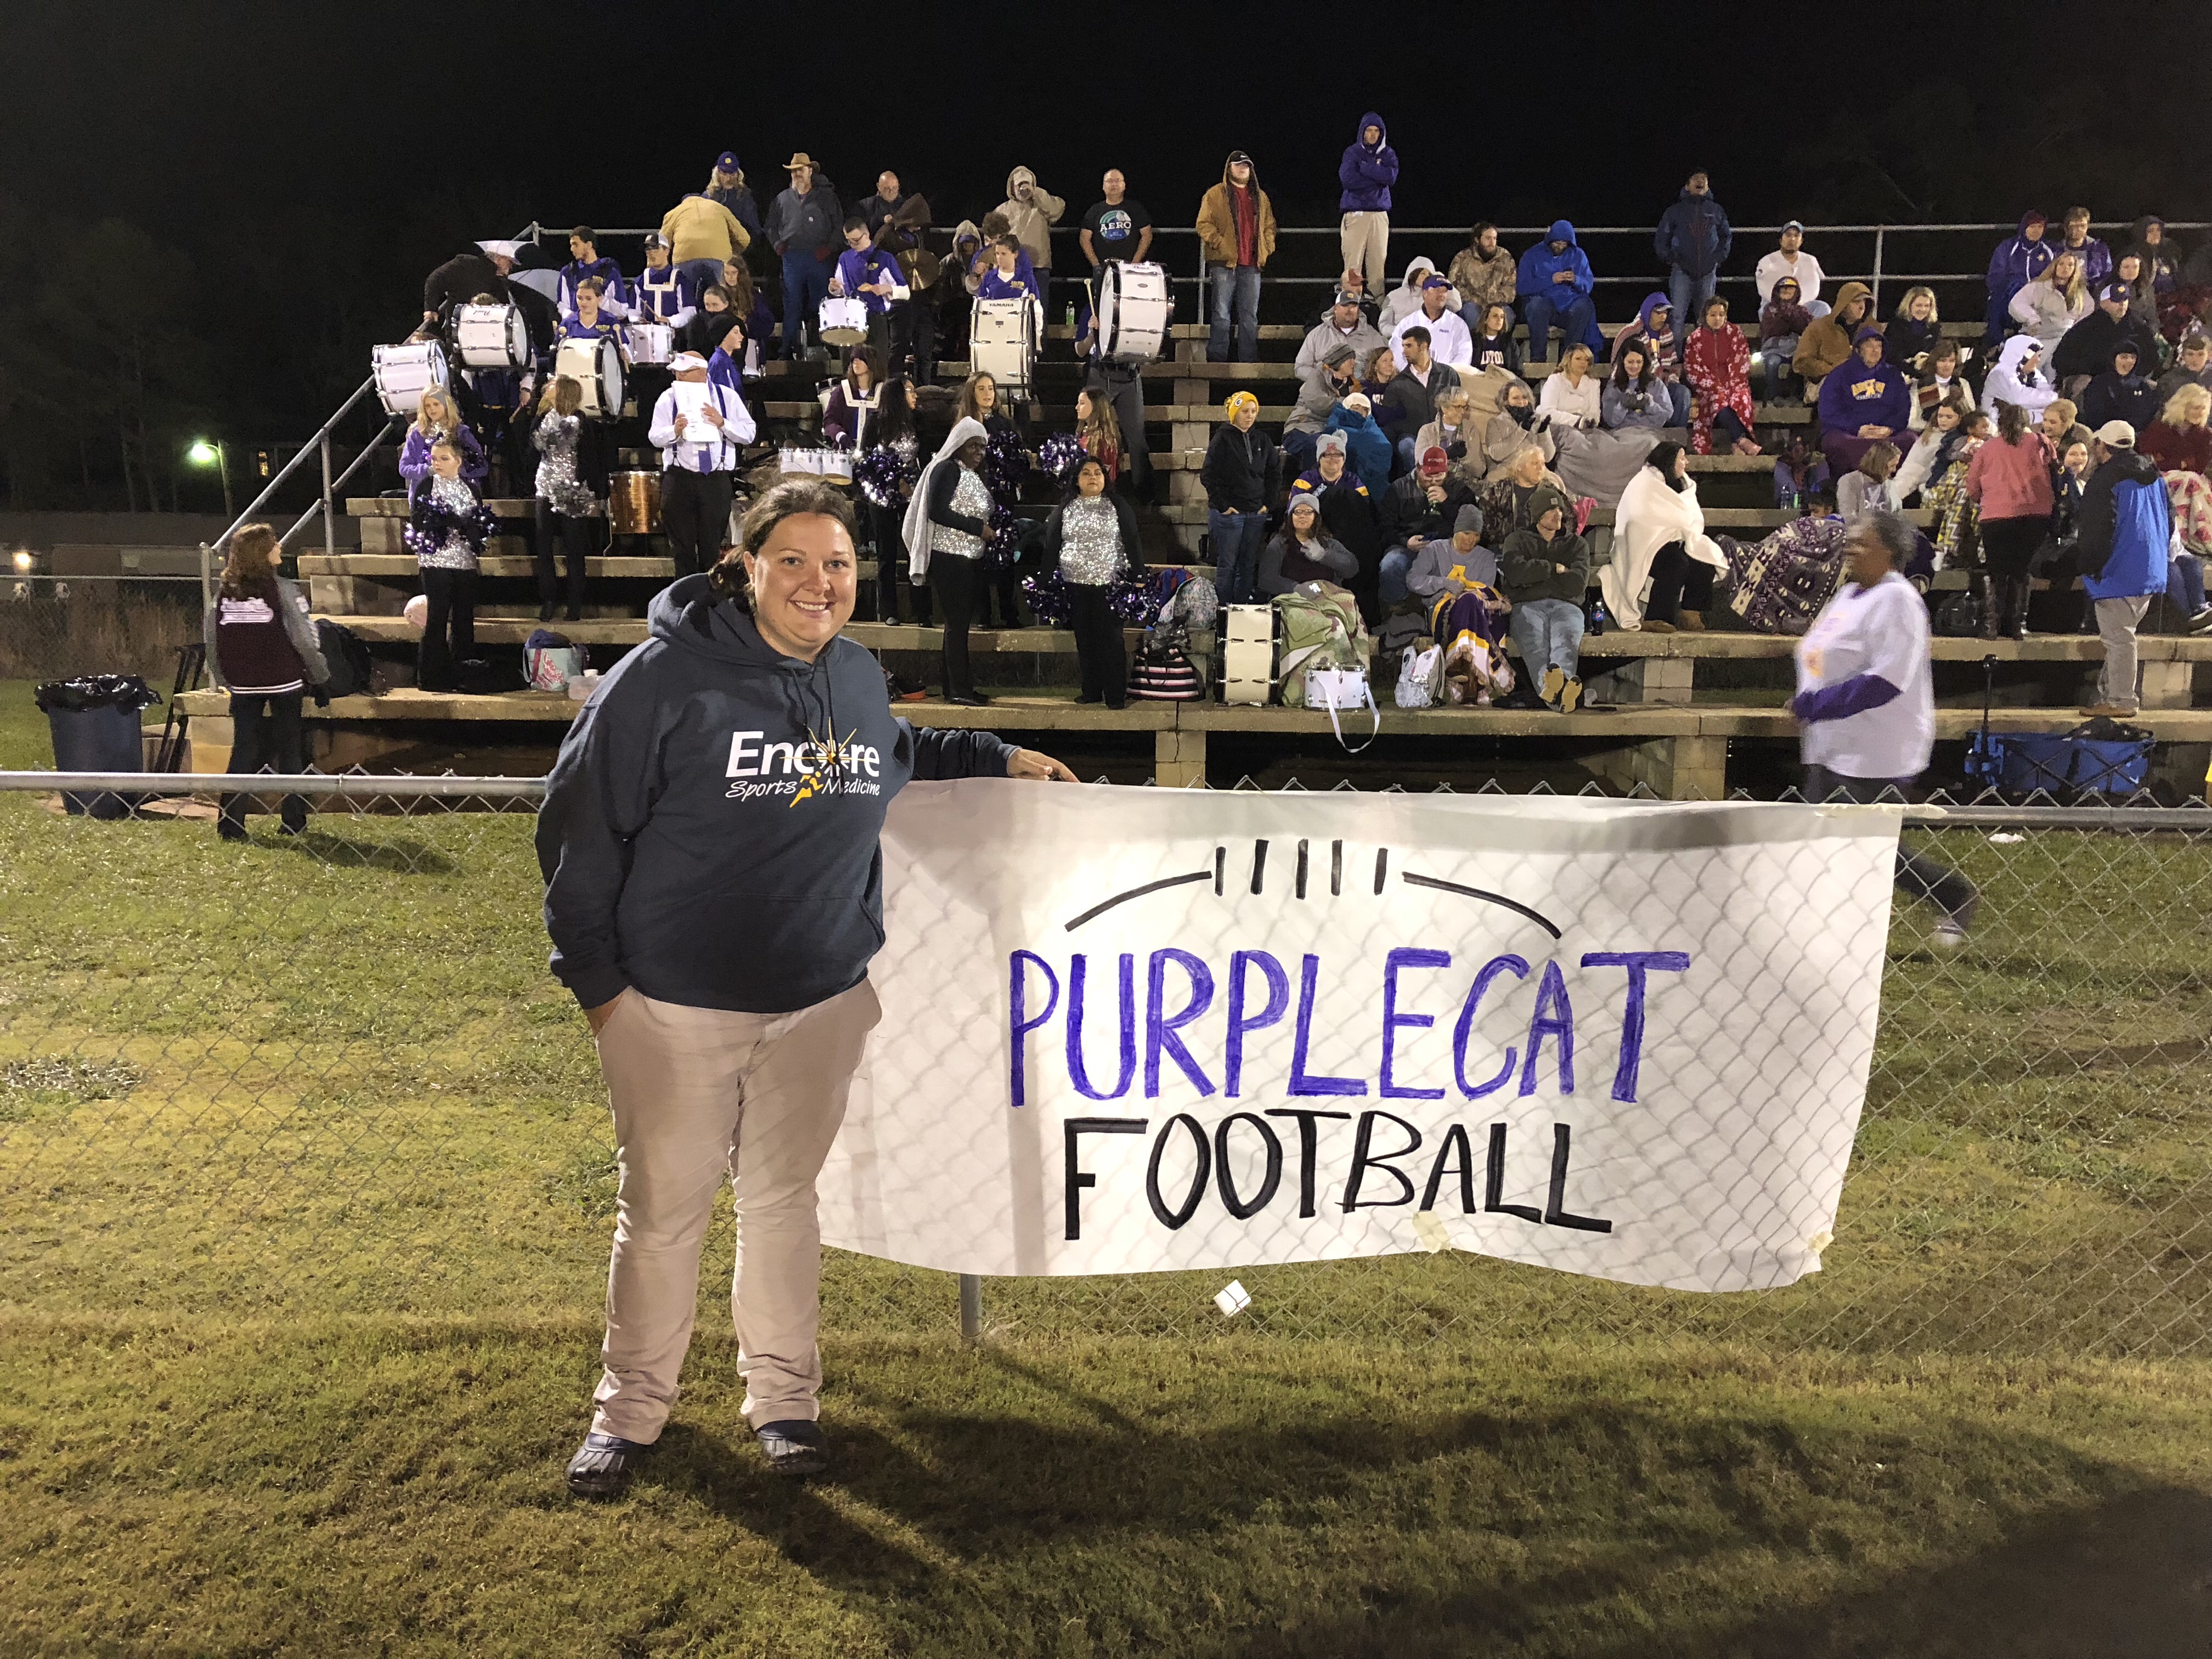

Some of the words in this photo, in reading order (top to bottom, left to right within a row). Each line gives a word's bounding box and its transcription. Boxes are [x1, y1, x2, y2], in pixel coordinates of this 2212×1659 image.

[1100, 221, 1132, 233] AERO
[725, 780, 797, 802] Sports
[821, 778, 881, 796] Medicine
[1064, 1109, 1612, 1240] FOOTBALL
